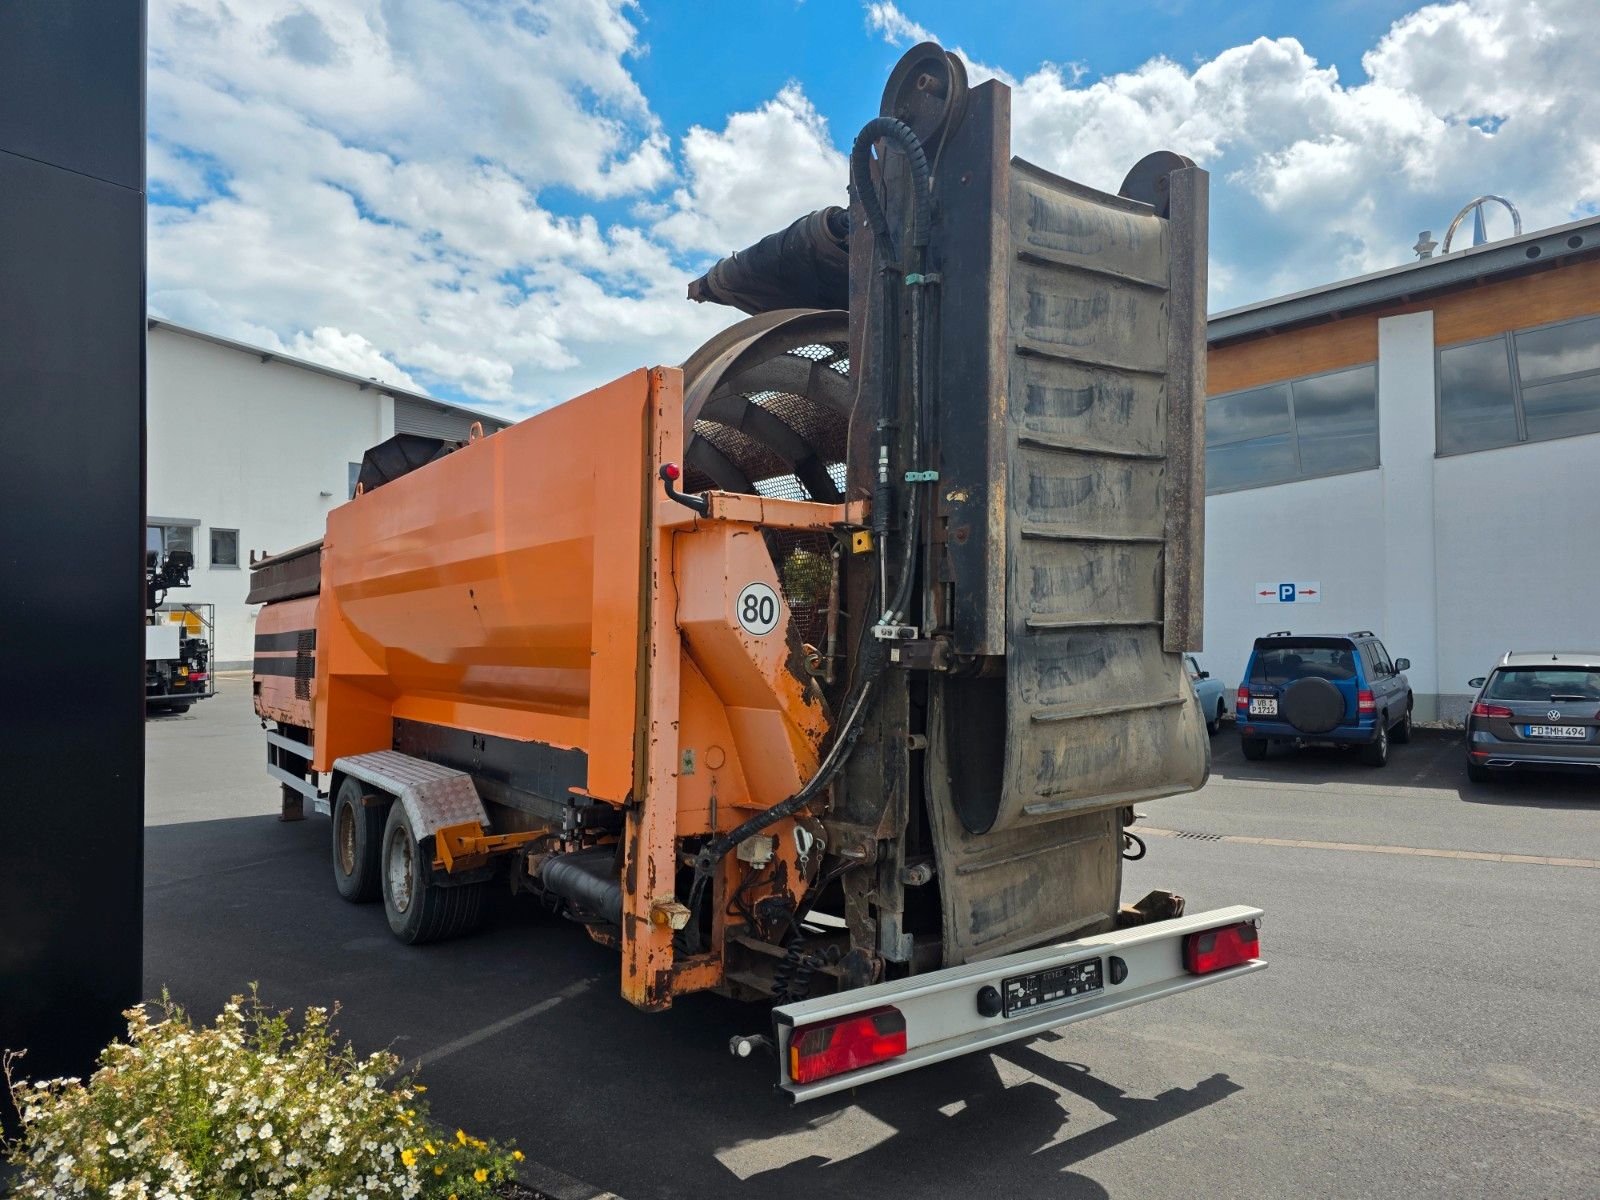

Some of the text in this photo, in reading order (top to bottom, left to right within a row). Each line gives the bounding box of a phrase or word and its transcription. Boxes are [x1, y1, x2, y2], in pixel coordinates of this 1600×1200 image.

[1282, 586, 1293, 600] P
[743, 594, 774, 624] 80
[1531, 726, 1584, 736] FD MH 494
